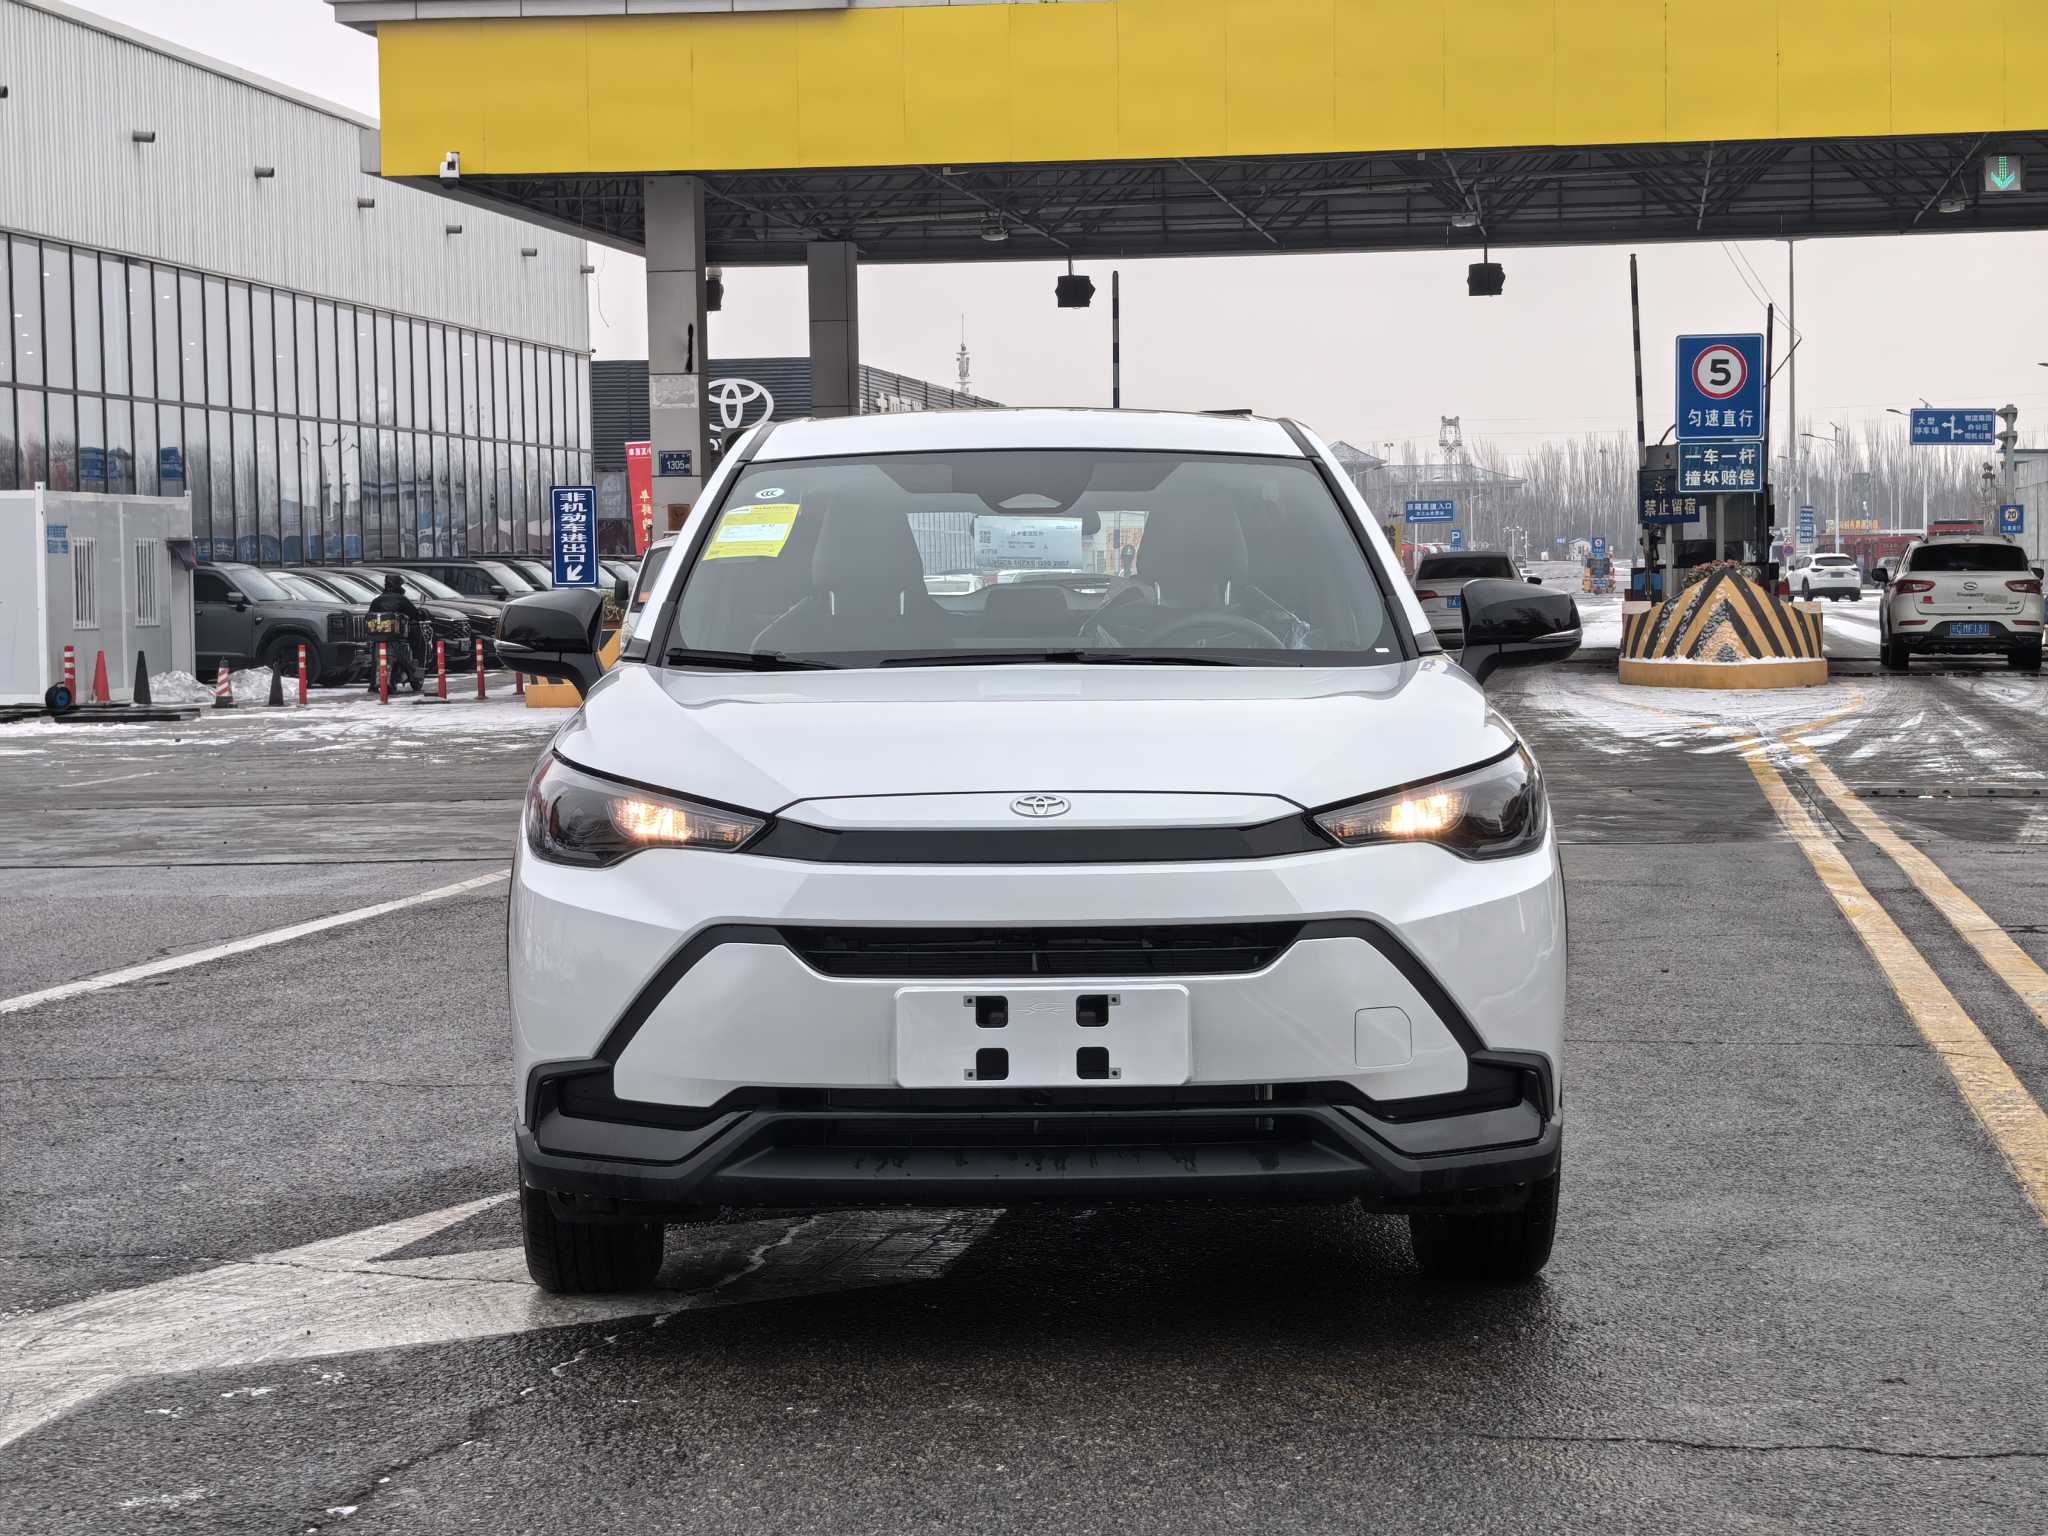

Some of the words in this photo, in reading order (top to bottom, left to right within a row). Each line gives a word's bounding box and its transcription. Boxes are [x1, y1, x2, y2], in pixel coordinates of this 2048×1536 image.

[1709, 358, 1732, 386] 5
[1688, 409, 1753, 427] 匀速直行
[1685, 448, 1755, 465] 一车一杆
[1685, 470, 1755, 486] 撞坏赔偿
[1644, 498, 1697, 517] 禁止留宿
[560, 492, 587, 562] 非机动车进出口
[1452, 532, 1460, 543] P
